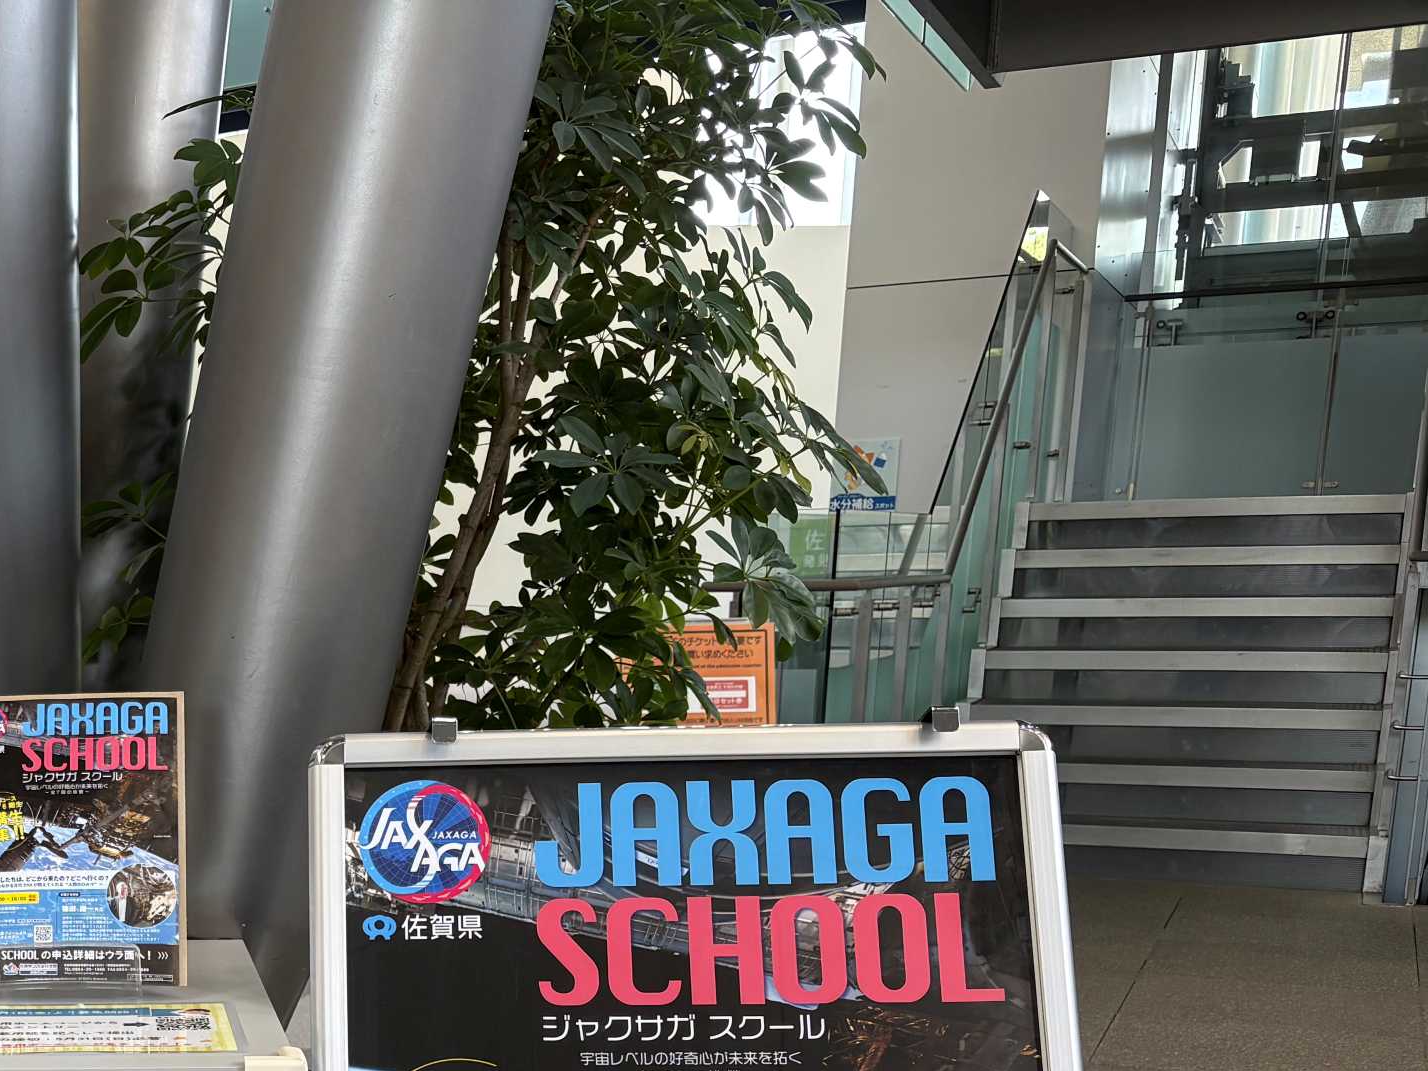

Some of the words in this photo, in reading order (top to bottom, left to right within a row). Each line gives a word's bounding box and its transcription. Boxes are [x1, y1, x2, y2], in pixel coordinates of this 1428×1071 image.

[22, 702, 169, 736] JAXAGA
[22, 736, 169, 771] SCHOOL
[80, 772, 123, 783] スクール
[432, 830, 477, 839] JAXAGA
[534, 776, 997, 888] JAXAGA
[401, 915, 483, 940] 佐賀県
[1, 950, 39, 960] SCHOOL
[536, 893, 1006, 1006] SCHOOL
[542, 1014, 696, 1041] ジャクサガ
[709, 1014, 826, 1040] スクール
[580, 1051, 802, 1066] 宇宙レベルの好奇心が未来を拓く
